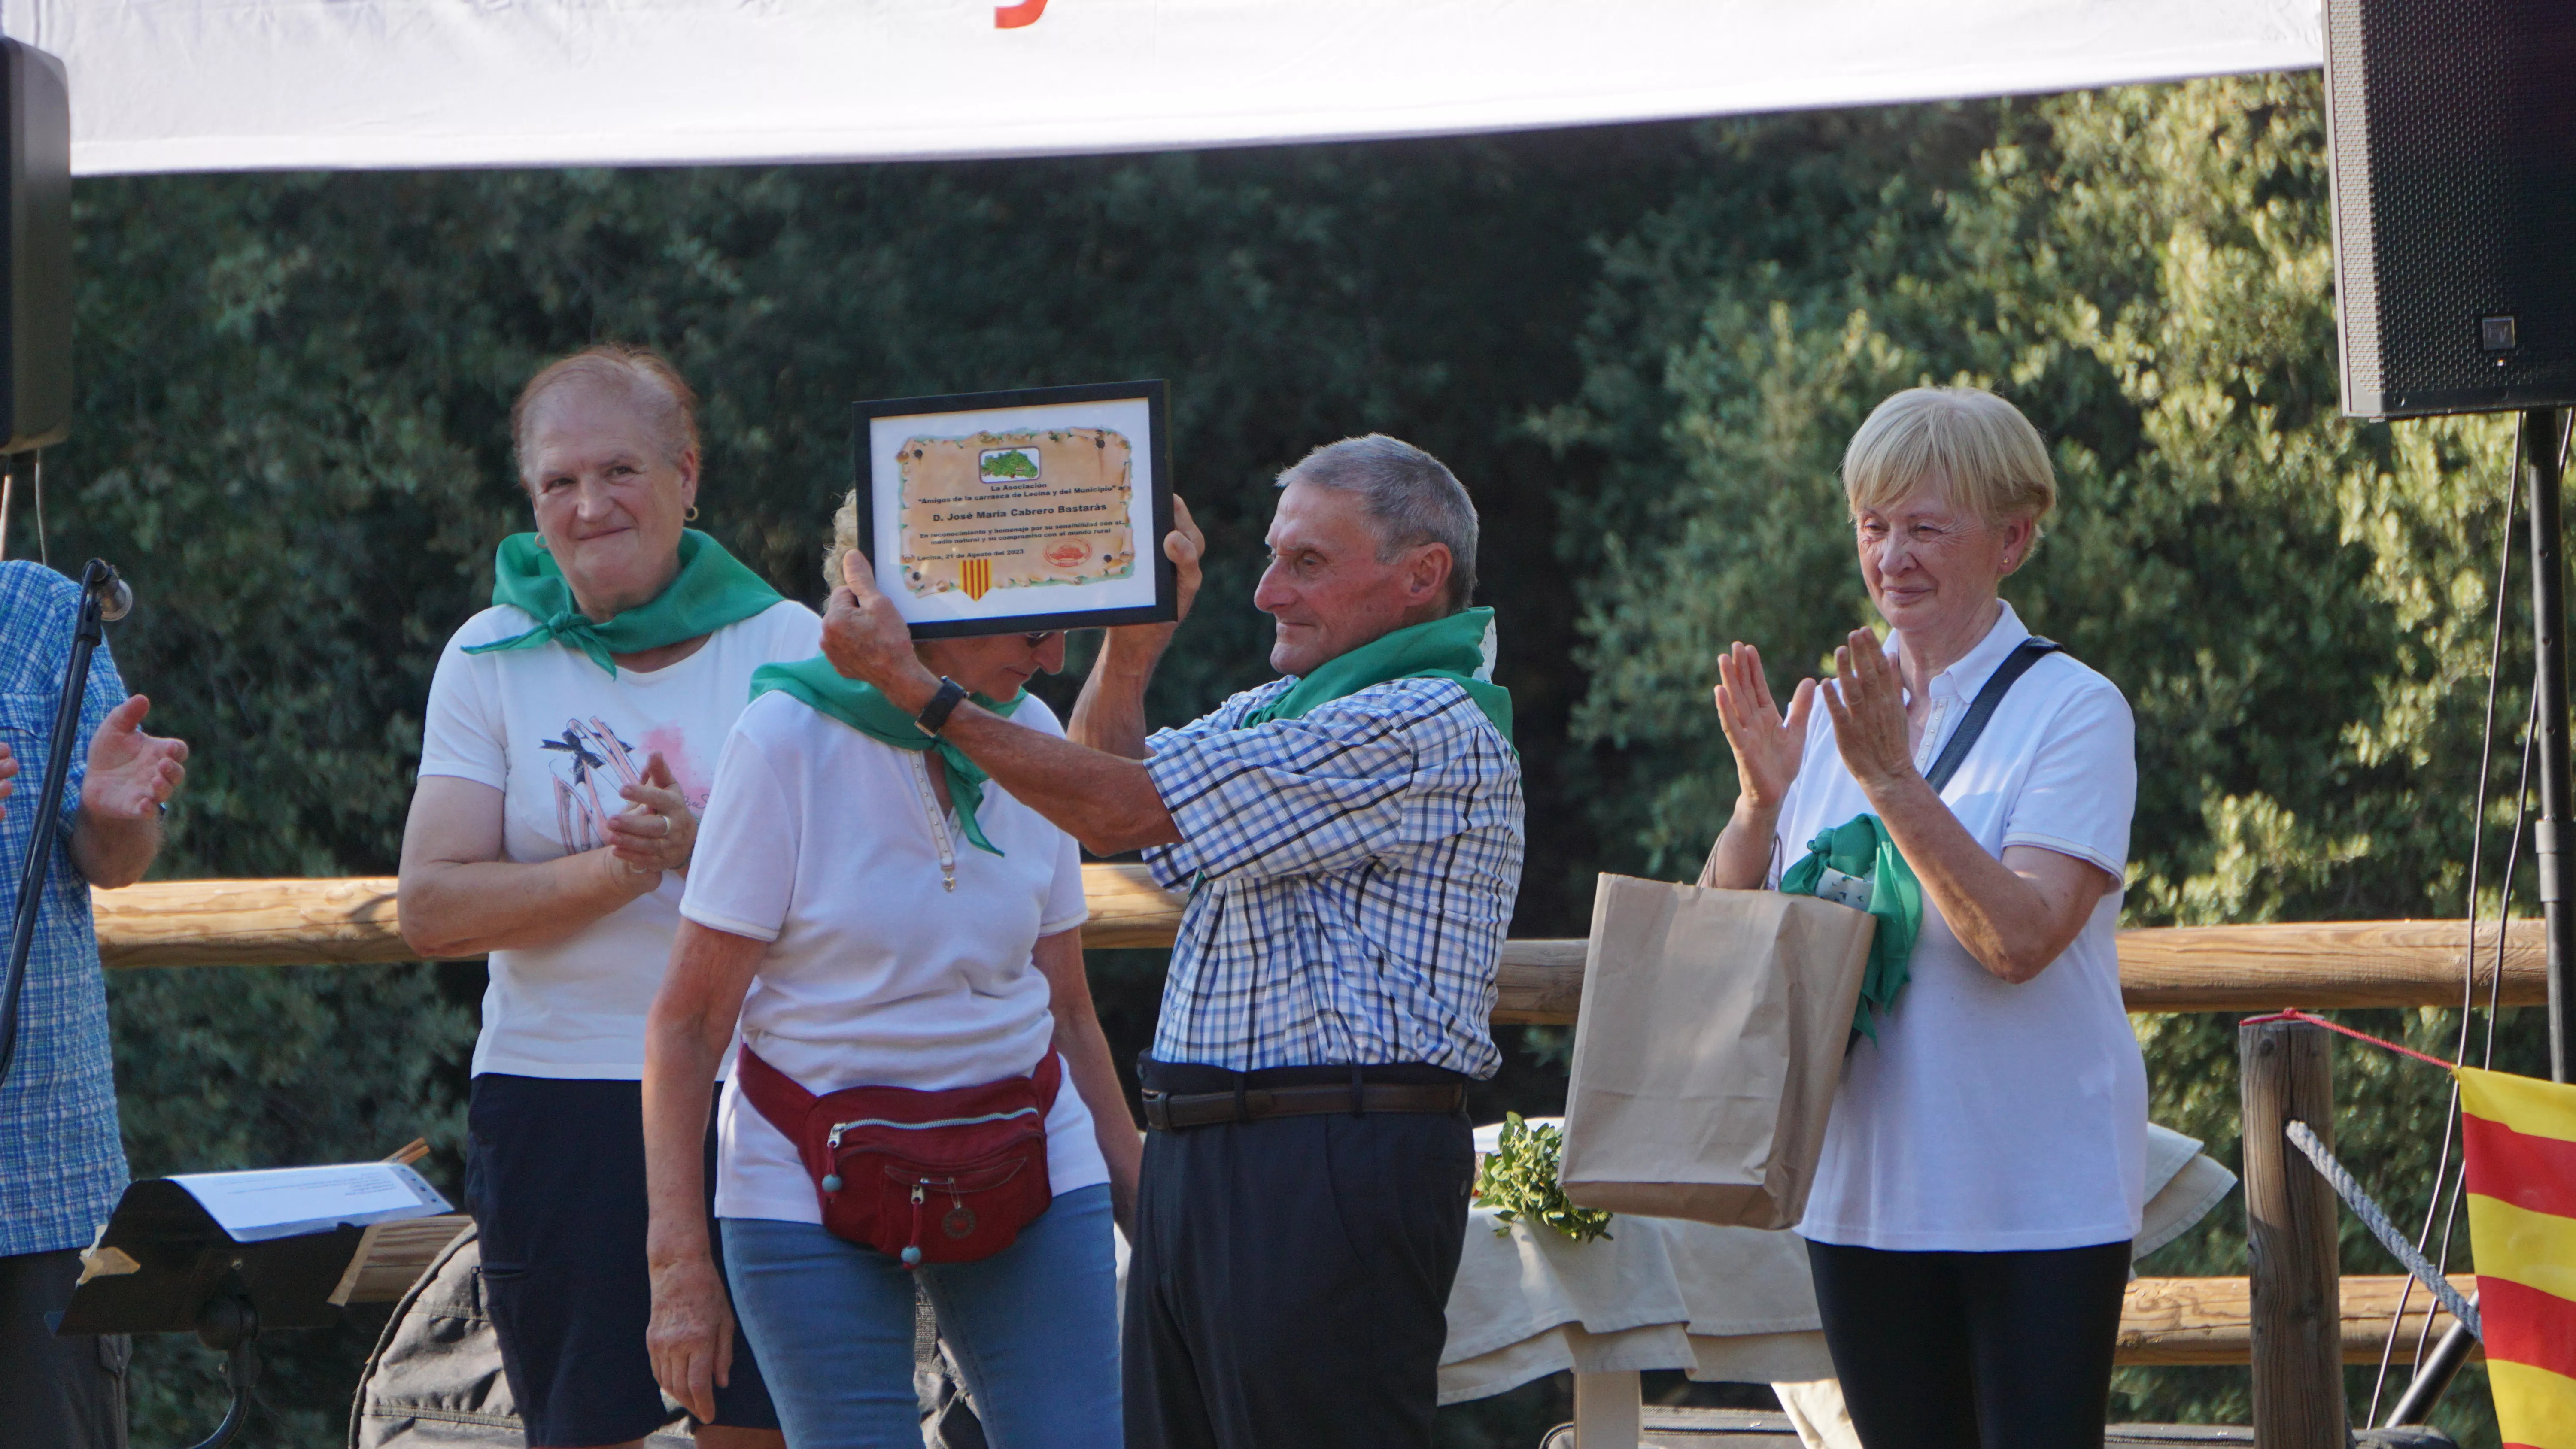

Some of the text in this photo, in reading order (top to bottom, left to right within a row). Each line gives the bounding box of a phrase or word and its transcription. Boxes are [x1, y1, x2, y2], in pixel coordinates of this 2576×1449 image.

[1003, 482, 1047, 491] Asociación
[947, 512, 973, 521] José
[976, 509, 1006, 518] María
[1058, 503, 1107, 513] Bastarás
[930, 529, 986, 538] reconocimiento
[998, 532, 1042, 540] compromiso
